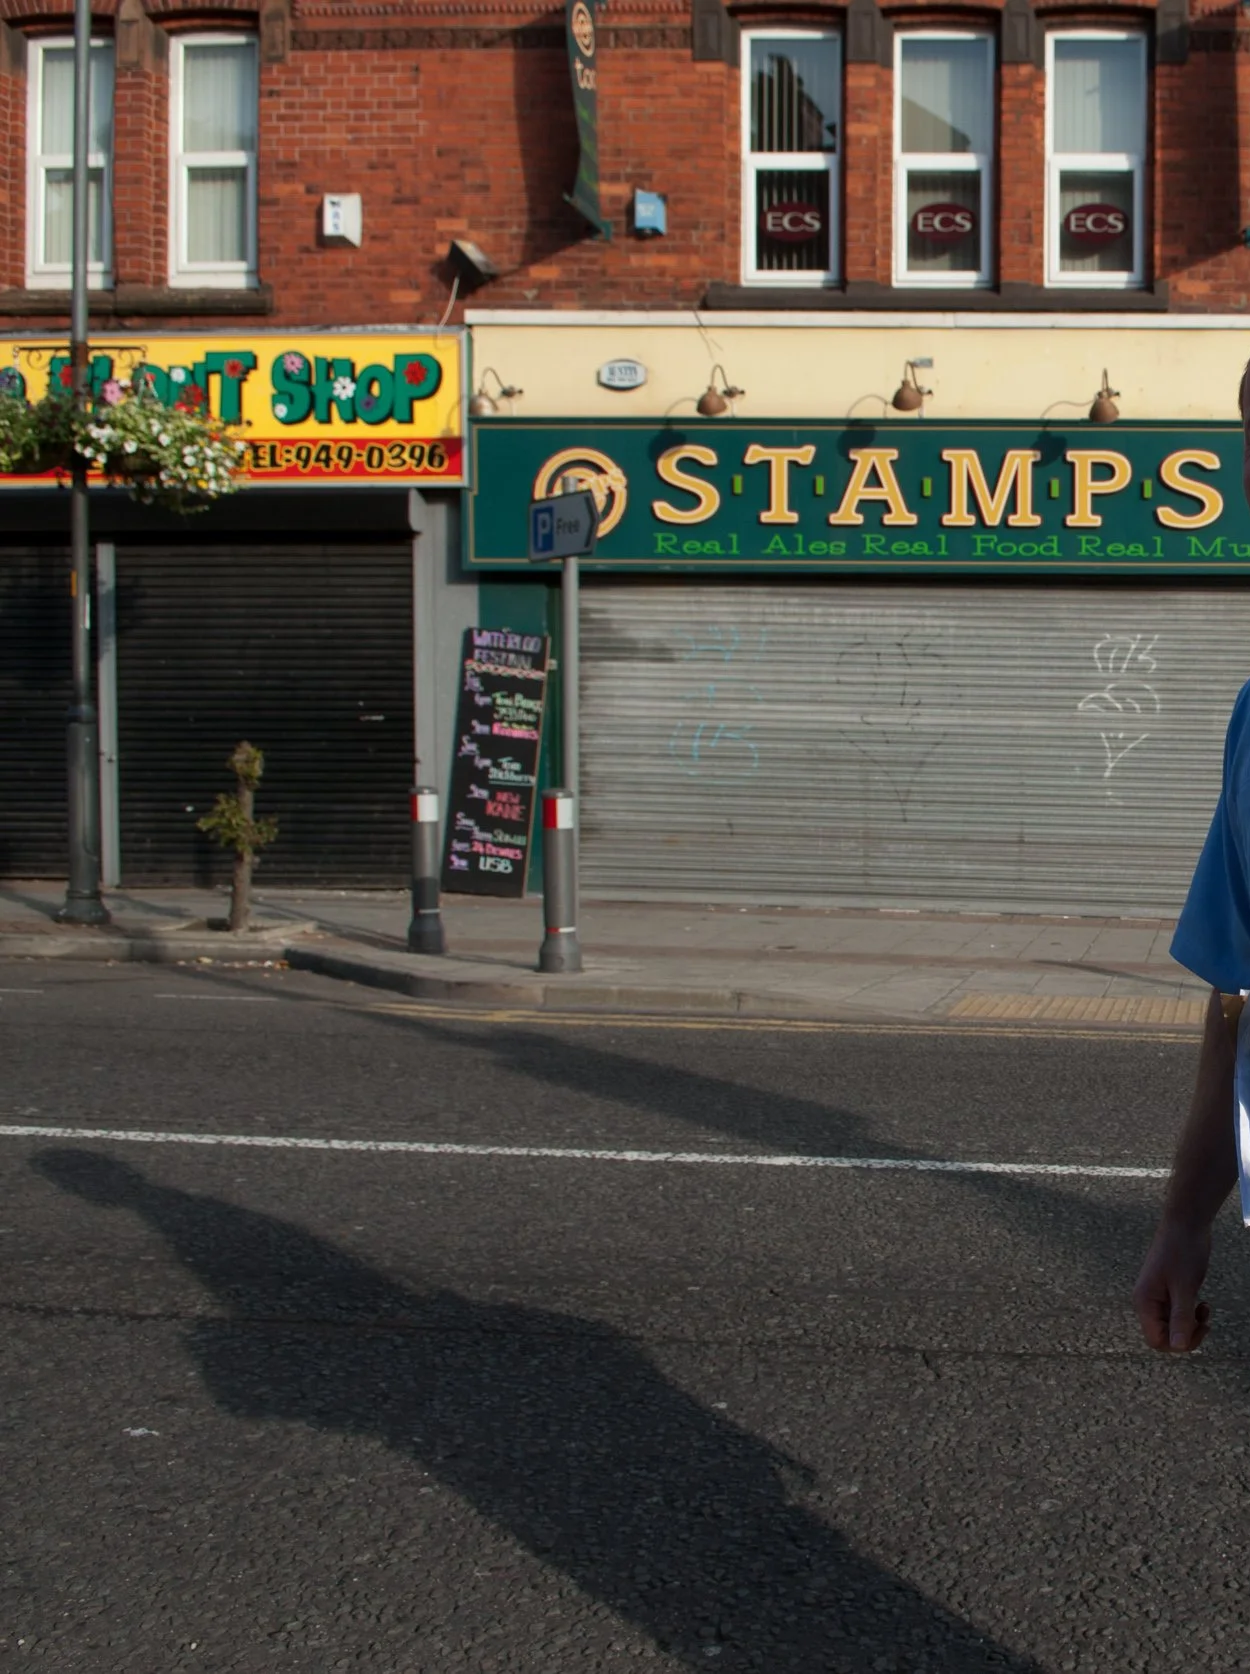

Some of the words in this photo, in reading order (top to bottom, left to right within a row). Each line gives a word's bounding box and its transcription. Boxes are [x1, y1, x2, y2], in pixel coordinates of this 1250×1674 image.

[765, 211, 822, 233] ECS
[917, 211, 973, 233] ECS
[1069, 212, 1125, 234] ECS
[271, 351, 442, 425] SHOP
[240, 442, 446, 471] EL:949-0396
[537, 513, 550, 549] P
[555, 517, 579, 535] Free
[653, 532, 740, 555] Real
[760, 533, 846, 555] Ales
[861, 532, 949, 556] Real
[971, 534, 1063, 557] Food
[1077, 534, 1165, 557] Real
[479, 856, 513, 874] USB
